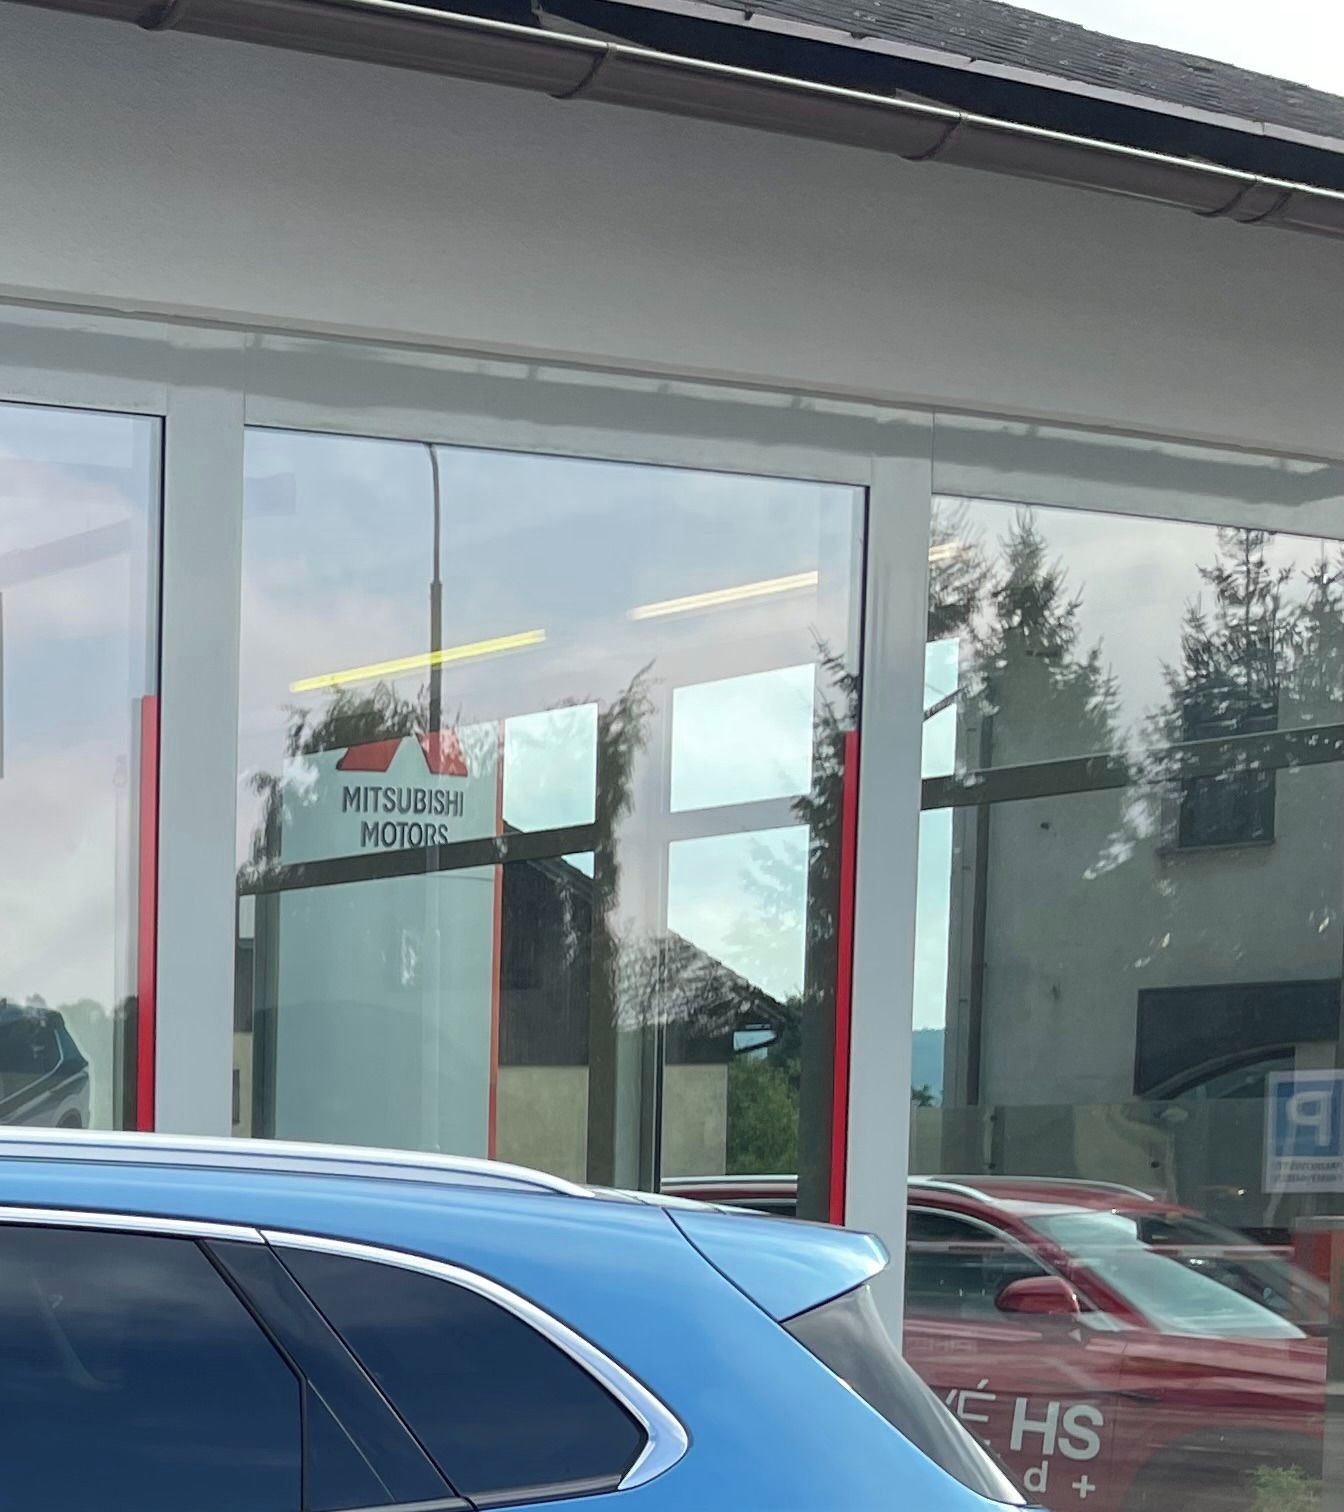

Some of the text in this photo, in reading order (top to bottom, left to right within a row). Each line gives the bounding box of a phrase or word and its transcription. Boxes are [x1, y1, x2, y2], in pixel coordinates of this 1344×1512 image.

[342, 785, 465, 817] MITSUBISHI
[359, 820, 449, 848] MOTORS
[1009, 1396, 1105, 1462] HS
